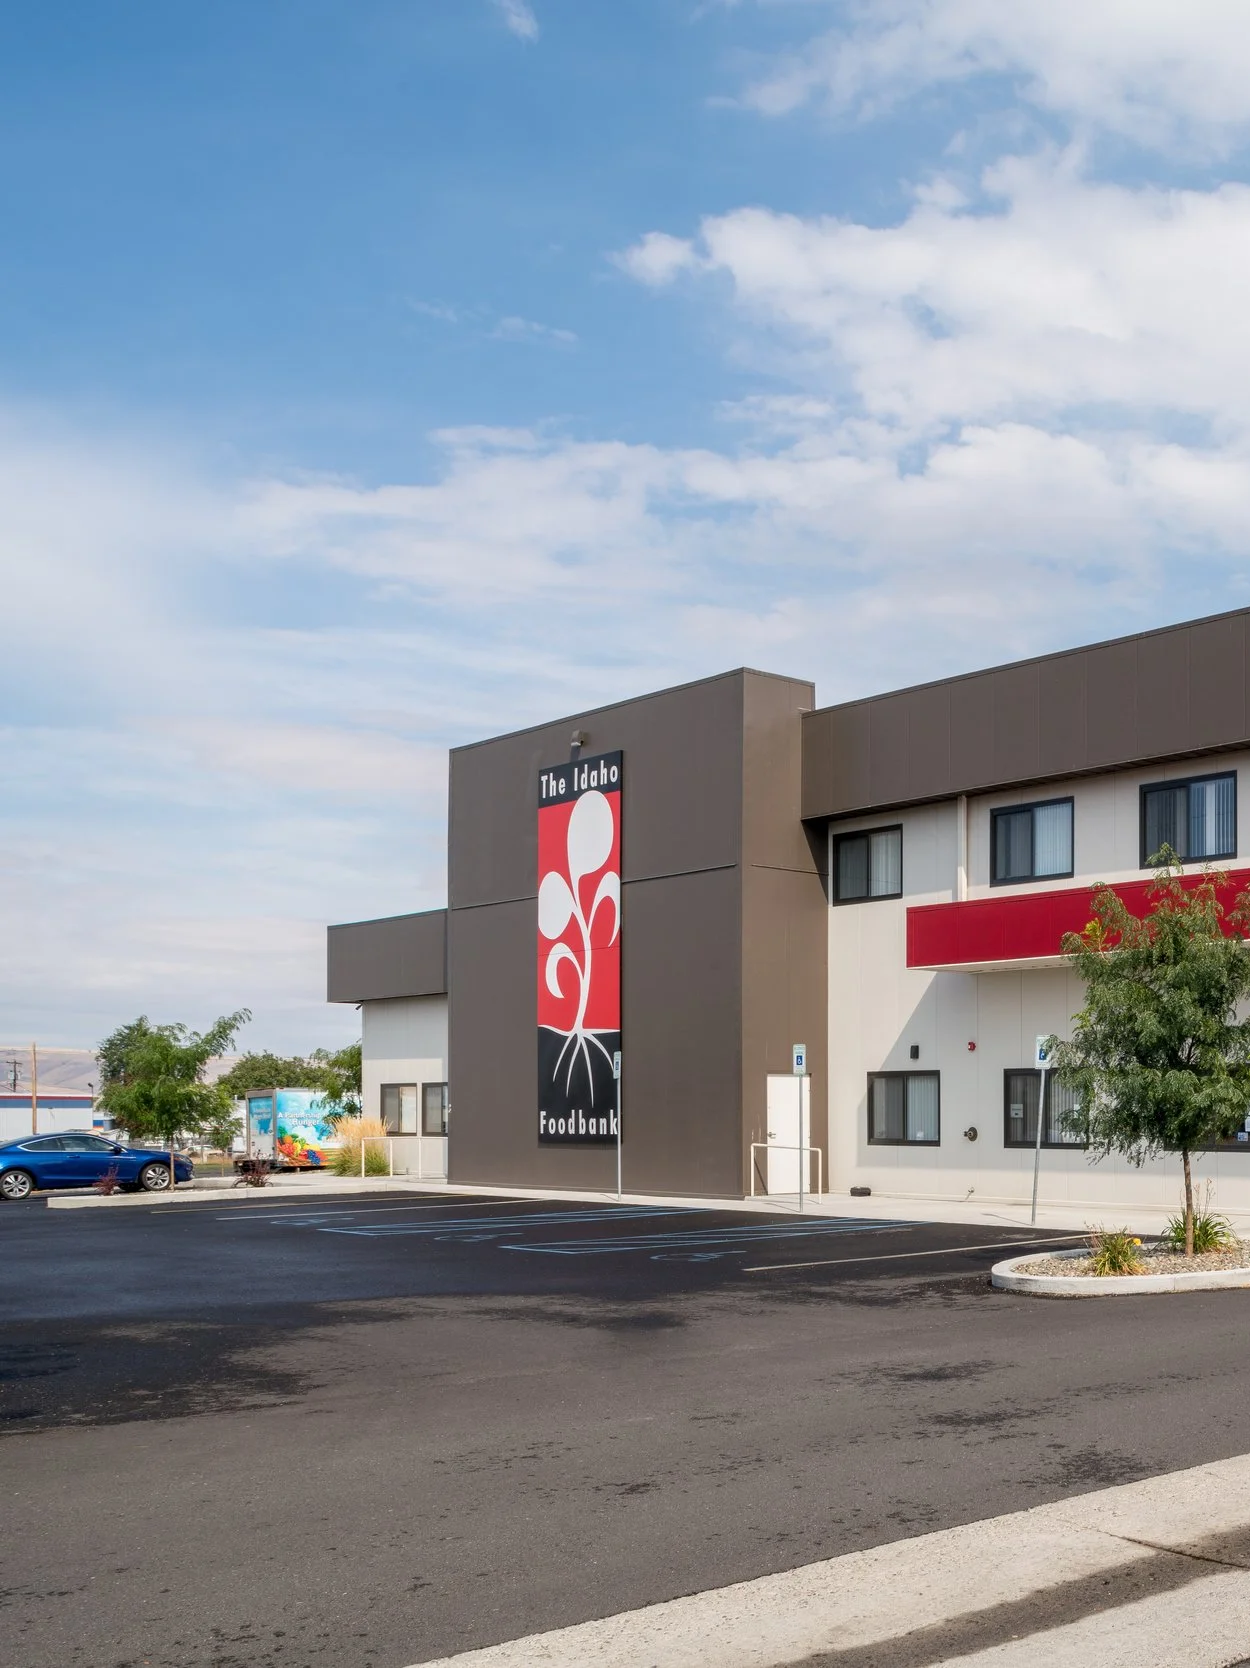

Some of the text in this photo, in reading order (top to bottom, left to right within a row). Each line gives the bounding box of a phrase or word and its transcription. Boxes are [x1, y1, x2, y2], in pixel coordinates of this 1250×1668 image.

[540, 760, 618, 799] The Idaho
[540, 1109, 618, 1135] Foodbank
